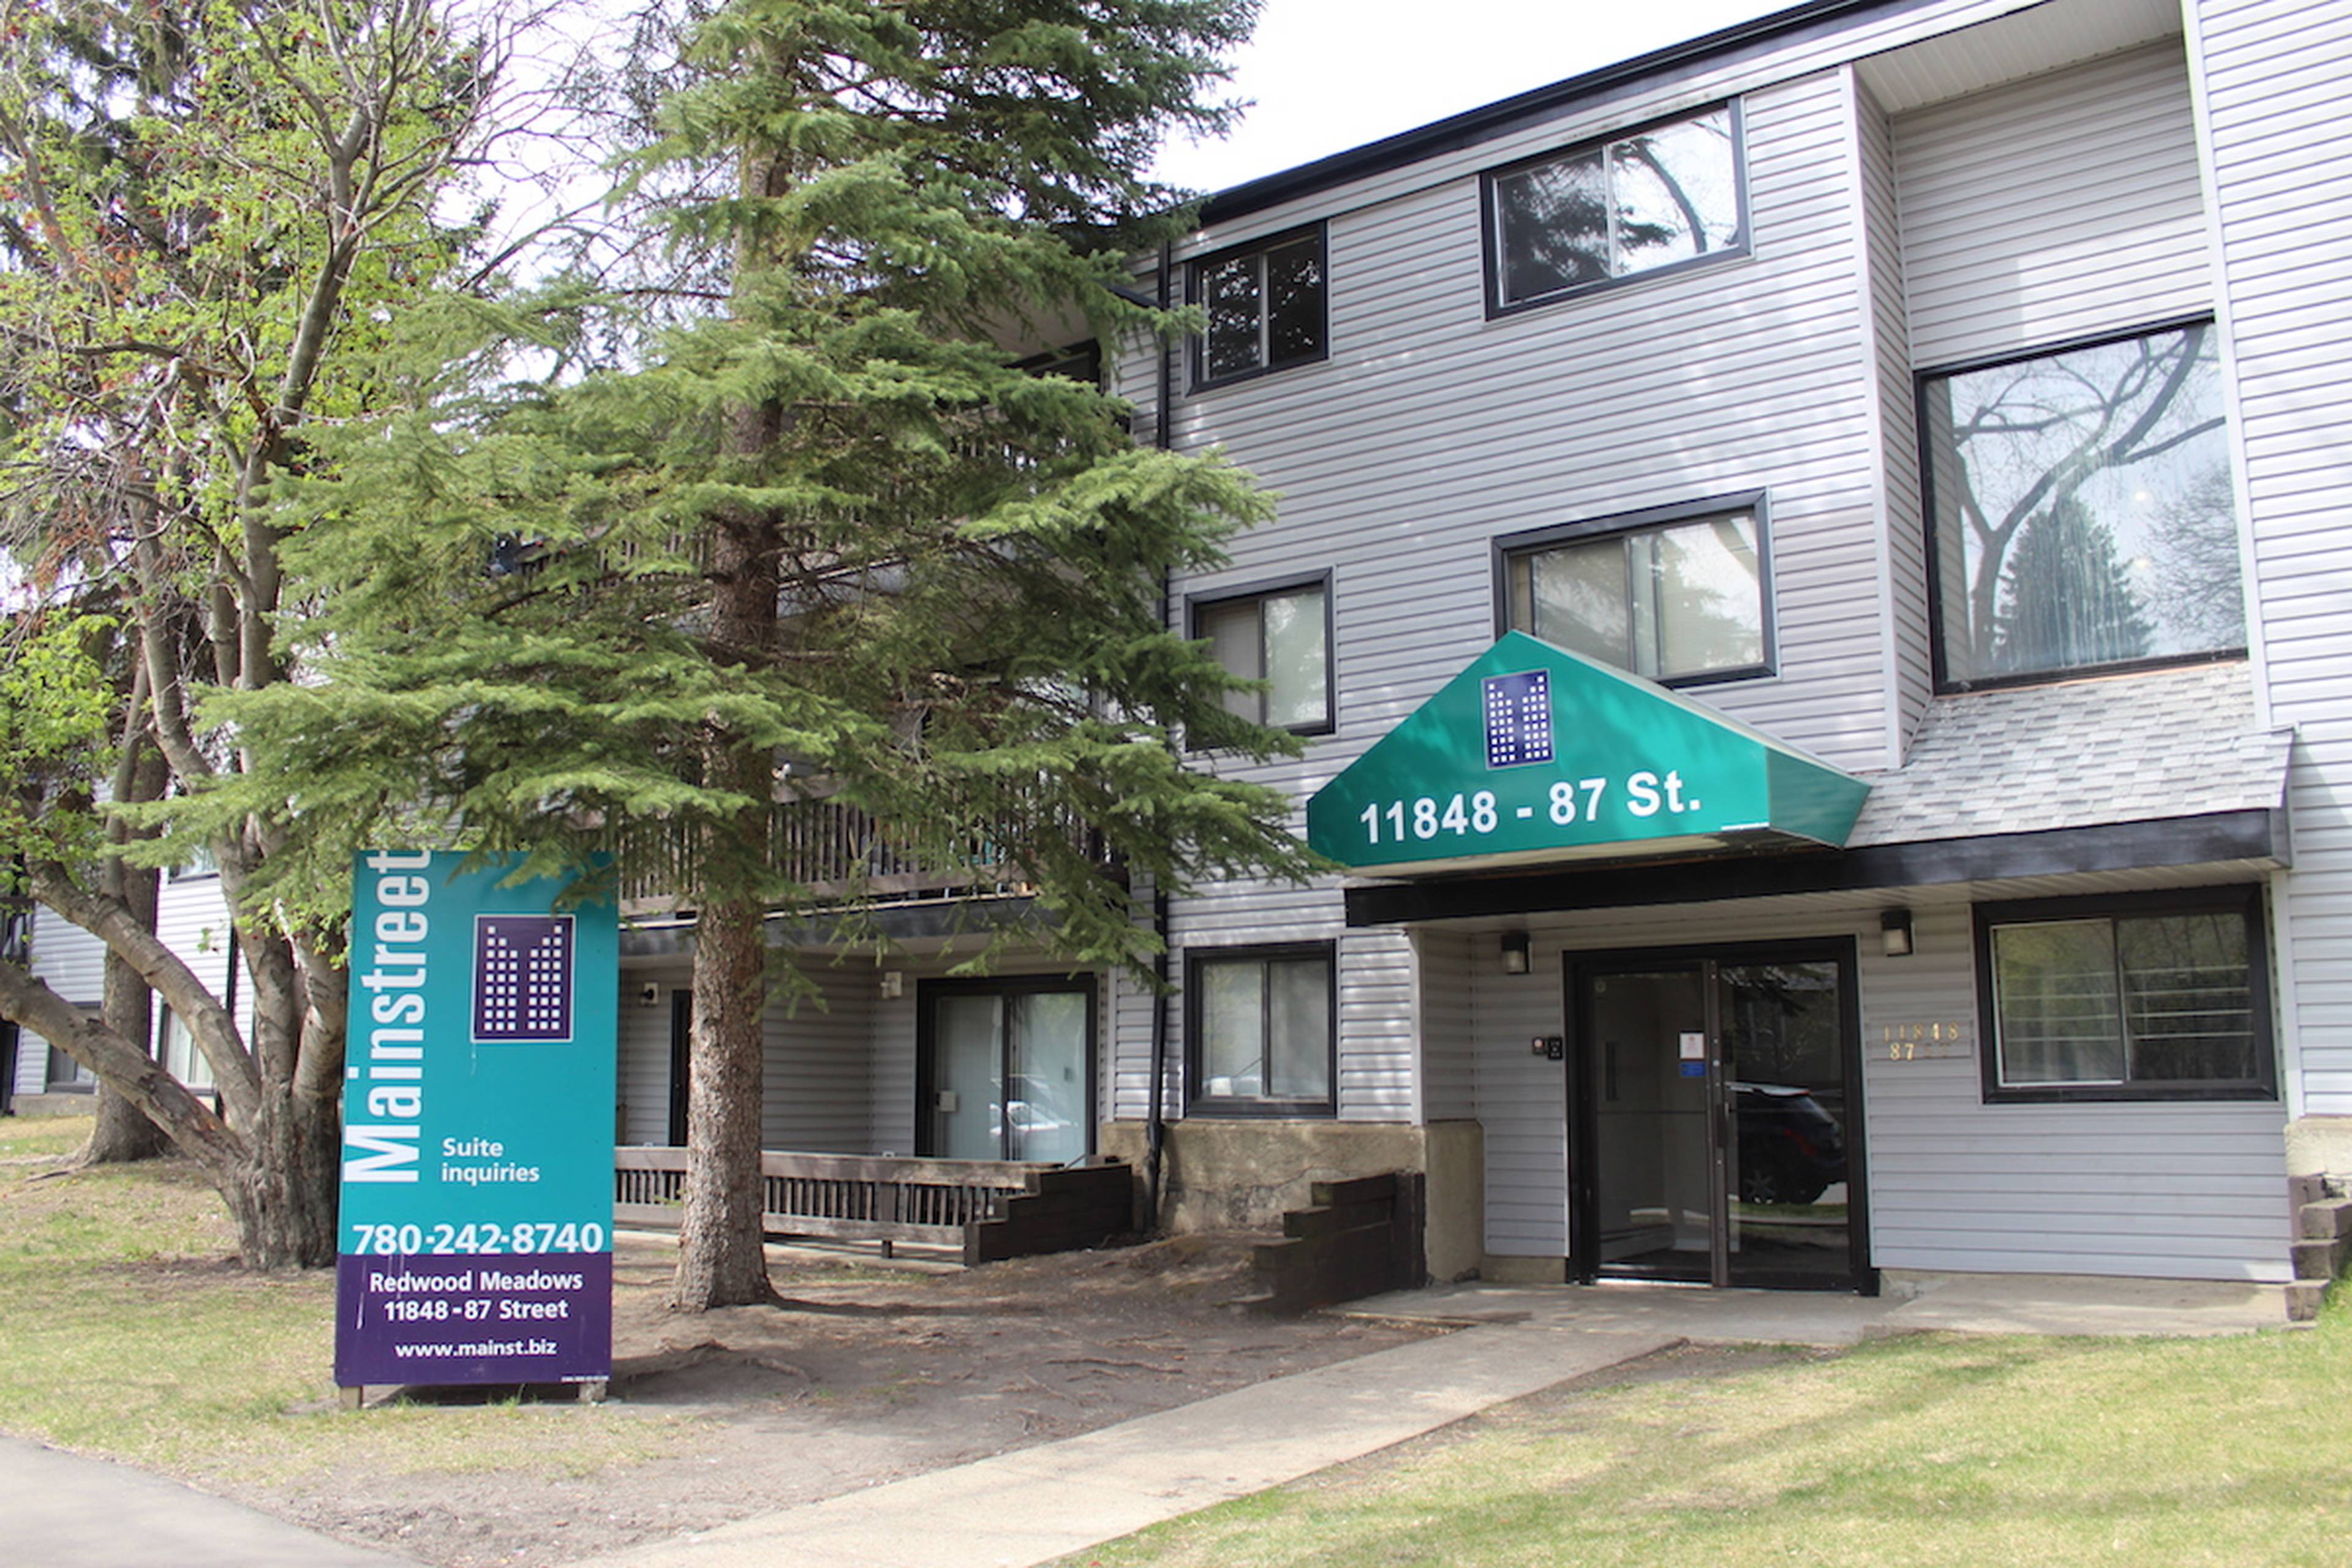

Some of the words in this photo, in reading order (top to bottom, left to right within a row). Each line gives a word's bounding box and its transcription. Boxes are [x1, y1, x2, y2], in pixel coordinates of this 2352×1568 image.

[1360, 790, 1498, 844] 11848
[1548, 777, 1607, 826] 87
[1626, 769, 1702, 818] St.
[343, 849, 431, 1183] Mainstreet
[1890, 1042, 1915, 1061] 87
[442, 1137, 503, 1157] Suite
[441, 1163, 540, 1186] inquiries
[352, 1223, 604, 1255] 780-242-8740
[369, 1270, 472, 1292] Redwood
[480, 1270, 583, 1291] Meadows
[499, 1299, 569, 1319] Street
[394, 1338, 558, 1357] www.mainst.biz
